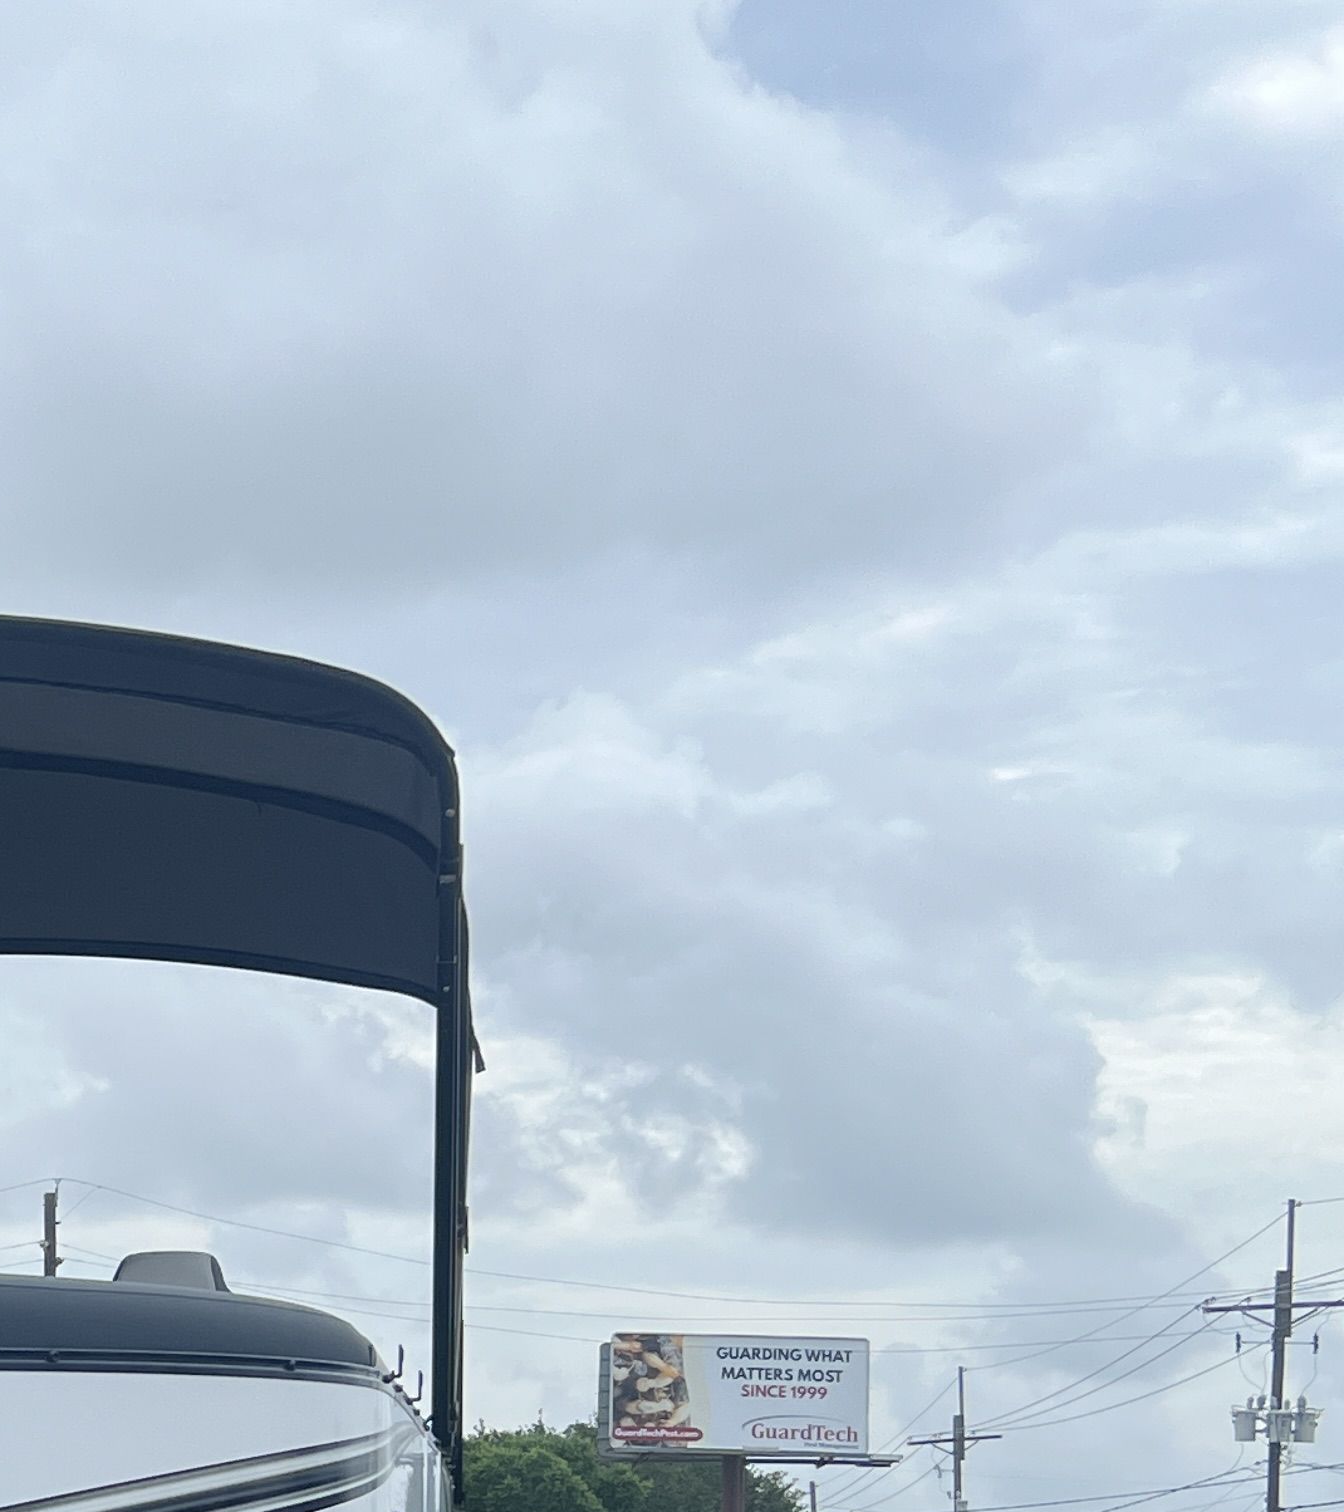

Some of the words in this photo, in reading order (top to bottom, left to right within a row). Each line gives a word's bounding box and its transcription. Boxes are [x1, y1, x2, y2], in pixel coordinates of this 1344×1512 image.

[716, 1346, 802, 1361] GUARDING
[805, 1348, 852, 1363] WHAT
[721, 1367, 793, 1381] MATTERS
[797, 1368, 843, 1383] MOST
[740, 1384, 787, 1399] SINCE
[790, 1386, 828, 1399] 1999
[751, 1422, 859, 1442] GuardTech
